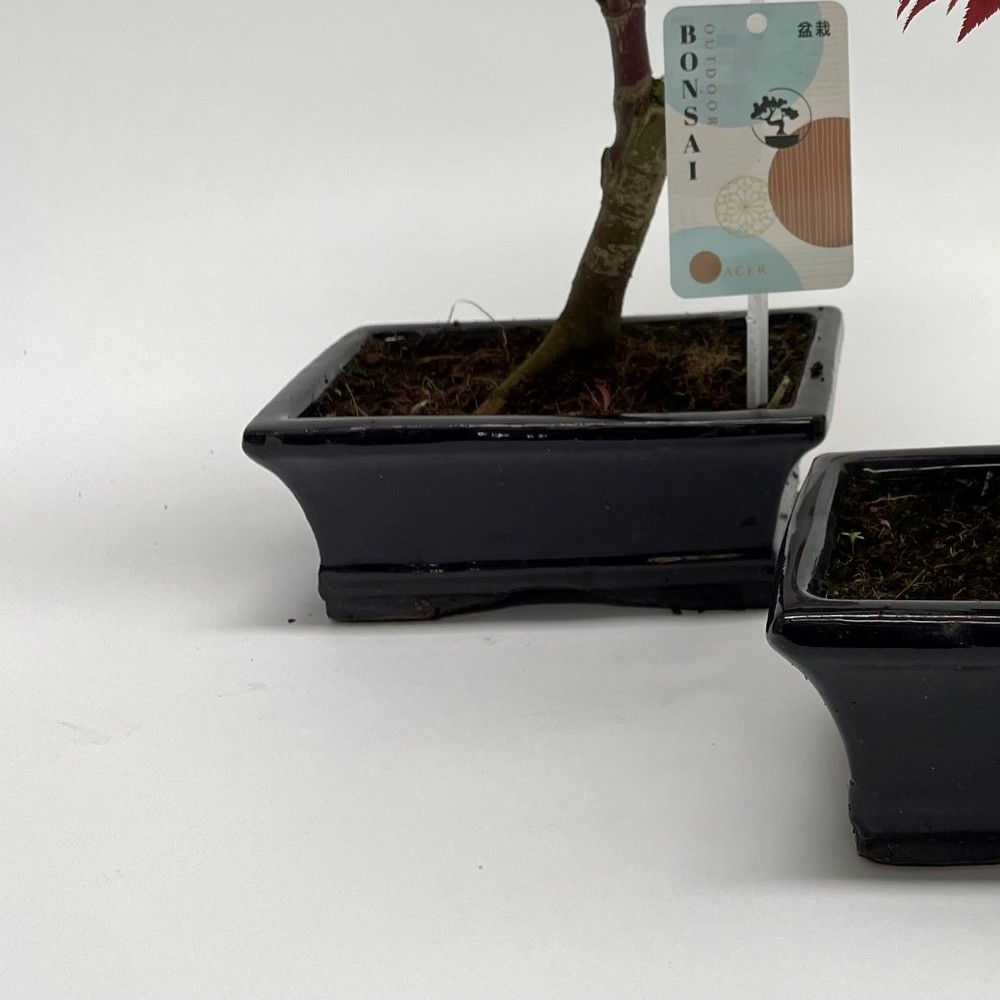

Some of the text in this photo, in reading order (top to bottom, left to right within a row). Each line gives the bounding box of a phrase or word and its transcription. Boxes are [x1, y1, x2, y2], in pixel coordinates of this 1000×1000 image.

[703, 23, 718, 126] OUTDOOR
[797, 20, 831, 39] 盆栽
[680, 24, 701, 181] BONSAI
